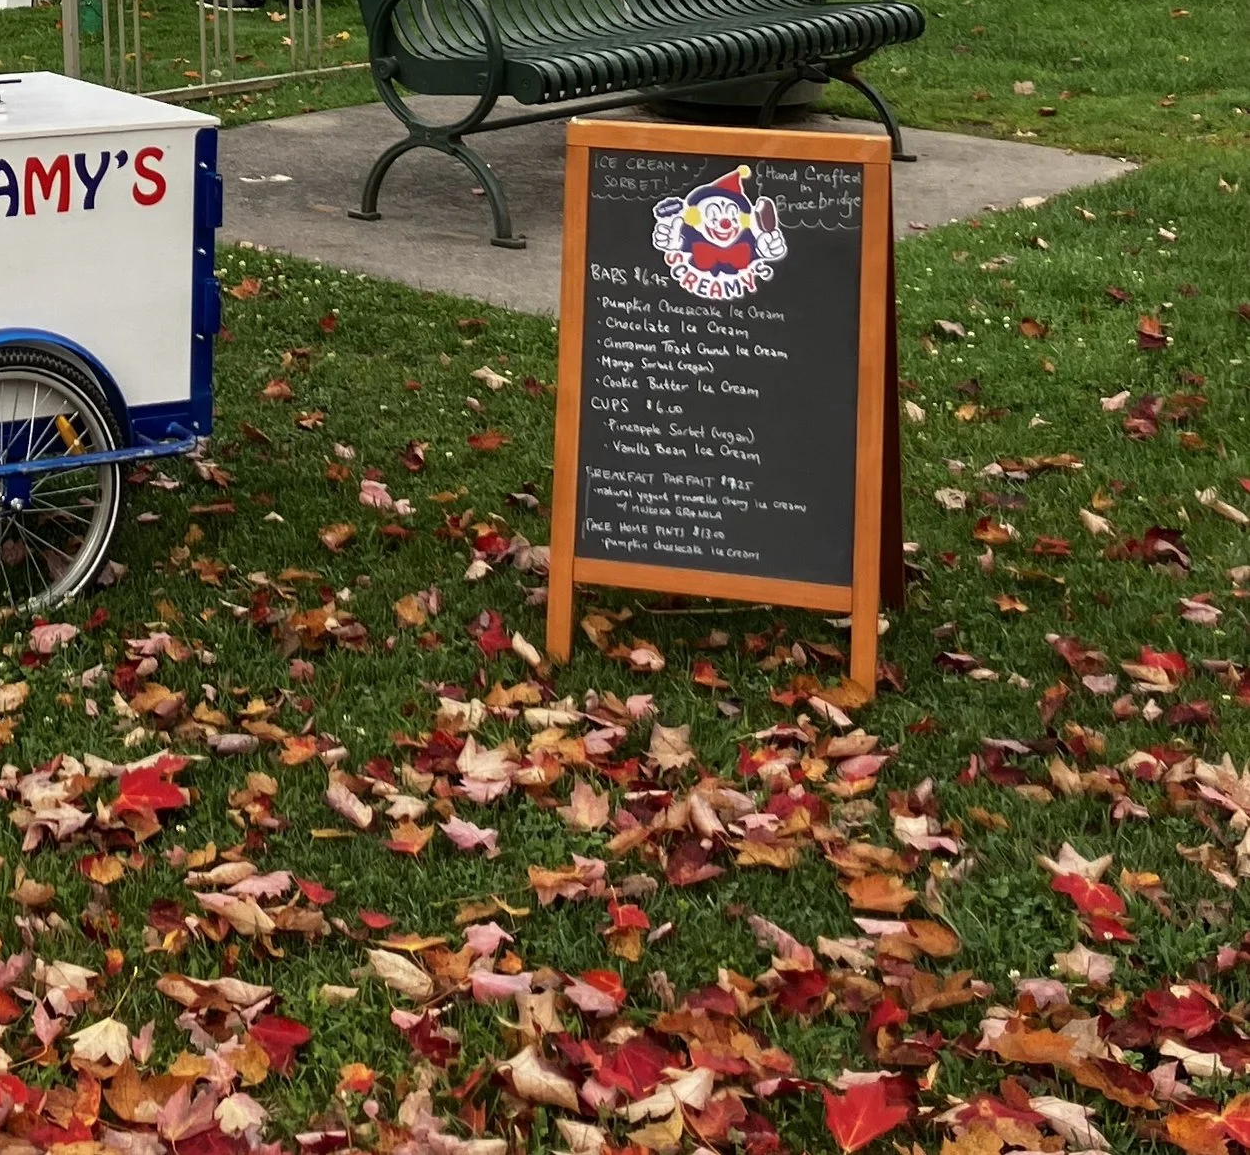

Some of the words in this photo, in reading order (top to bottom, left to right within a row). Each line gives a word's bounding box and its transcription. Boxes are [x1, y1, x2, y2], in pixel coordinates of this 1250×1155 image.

[594, 155, 618, 170] ICE
[625, 157, 676, 172] CREAM
[764, 163, 798, 183] Hand
[804, 164, 862, 185] Crafted
[604, 174, 669, 192] SORBET!
[799, 183, 812, 193] in
[590, 263, 628, 285] BARS
[665, 252, 774, 298] SCREAMY'S
[602, 296, 651, 315] Pumpkin
[658, 298, 723, 319] Cheesecake
[729, 304, 744, 320] Ice
[747, 305, 785, 322] Cream
[605, 316, 670, 334] Chocolate
[680, 320, 697, 334] Ice
[707, 320, 749, 340] Cream
[660, 339, 691, 355] Toast
[697, 342, 730, 357] Crunch
[736, 344, 749, 357] Ice
[754, 344, 789, 360] Cream
[601, 355, 634, 372] Mango
[641, 357, 674, 372] Sorbet
[677, 360, 715, 375] (vegan)
[602, 375, 639, 390] Cookie
[646, 375, 689, 392] Butter
[697, 379, 715, 394] Ice
[720, 380, 760, 398] Cream
[590, 396, 630, 413] CUPS
[607, 418, 662, 436] Pineapple
[669, 422, 705, 438] Sorbet
[711, 426, 756, 445] (vegan)
[612, 440, 651, 456] Vanilla
[655, 442, 687, 458] Bean
[694, 443, 715, 457] Ice
[719, 444, 762, 466] Cream
[585, 465, 654, 484] BREAKFAST
[662, 471, 716, 488] PARFAIT
[596, 487, 633, 499] natural
[636, 490, 669, 504] yogurt
[753, 498, 768, 510] ice
[586, 517, 612, 532] TAKE
[619, 521, 649, 534] HOME
[655, 525, 685, 538] PINTS
[604, 536, 648, 552] pumpkin
[653, 541, 704, 555] cheesecake
[711, 543, 725, 557] ice
[726, 547, 761, 560] cream
